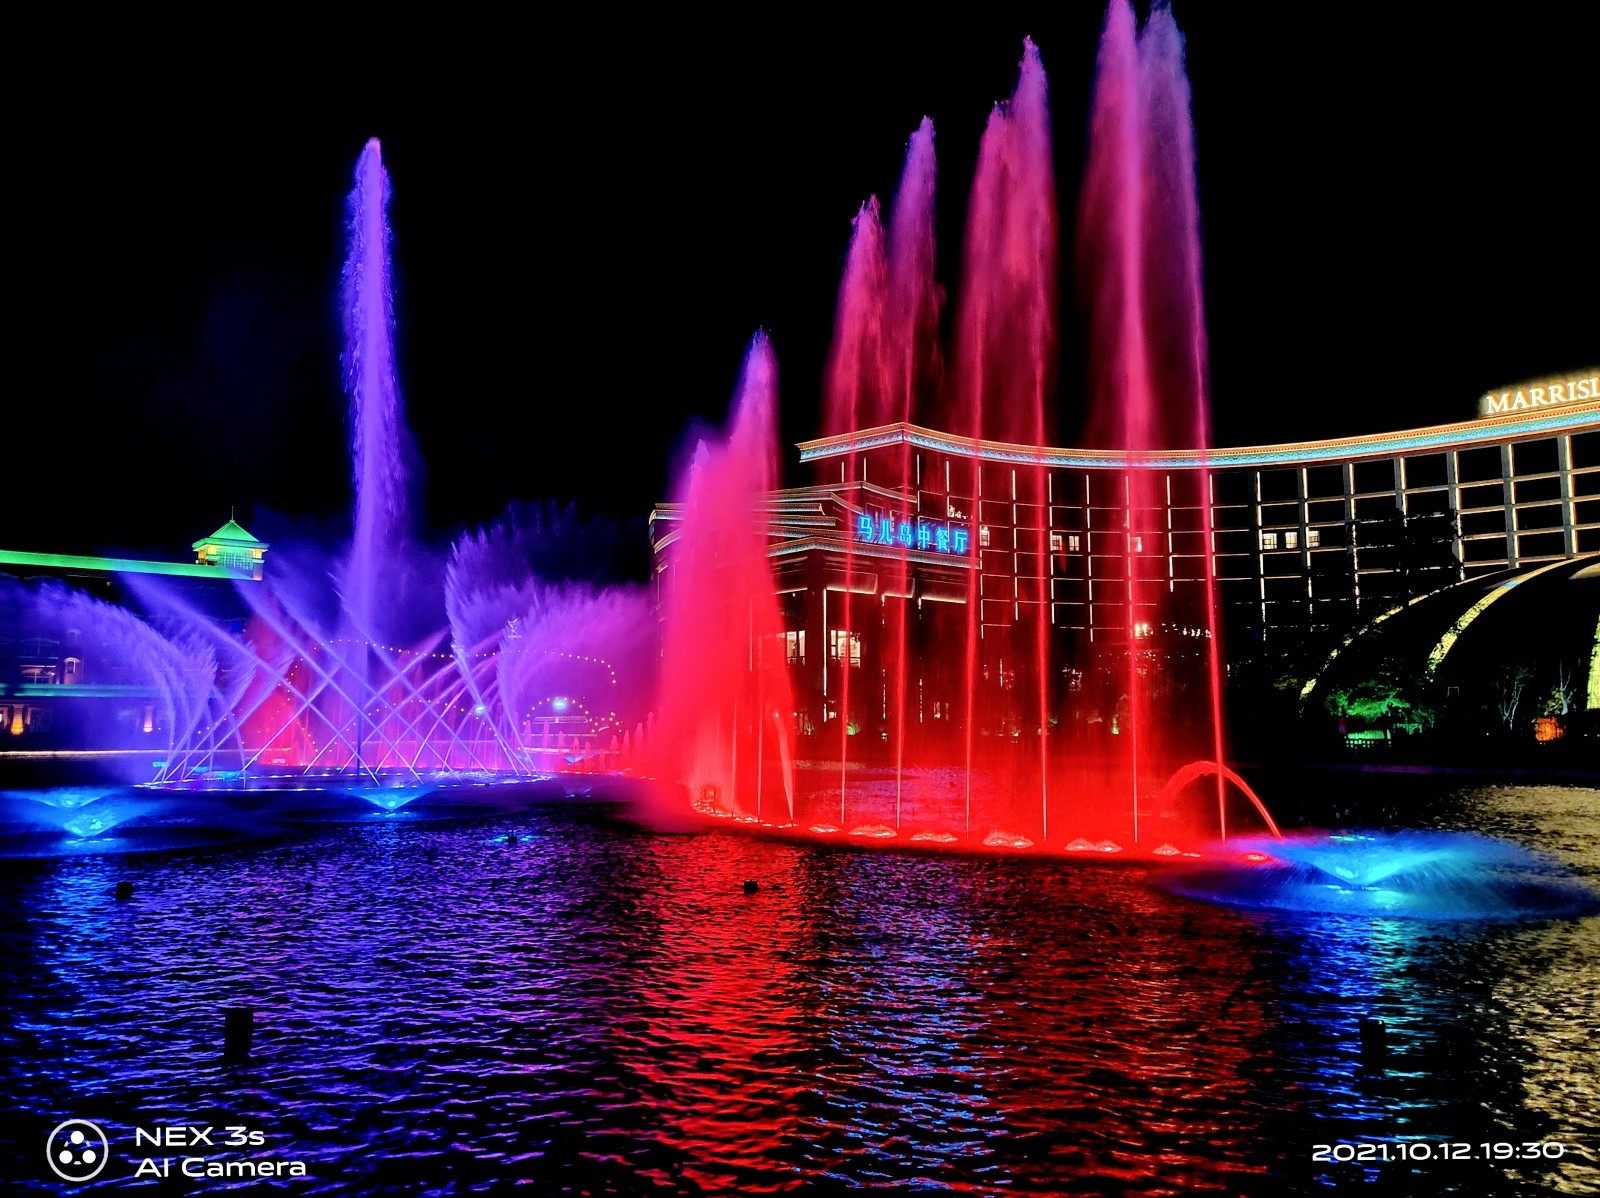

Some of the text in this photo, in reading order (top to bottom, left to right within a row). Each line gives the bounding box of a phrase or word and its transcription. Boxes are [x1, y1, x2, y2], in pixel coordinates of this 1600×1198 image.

[858, 515, 968, 553] 马儿岛中餐厅
